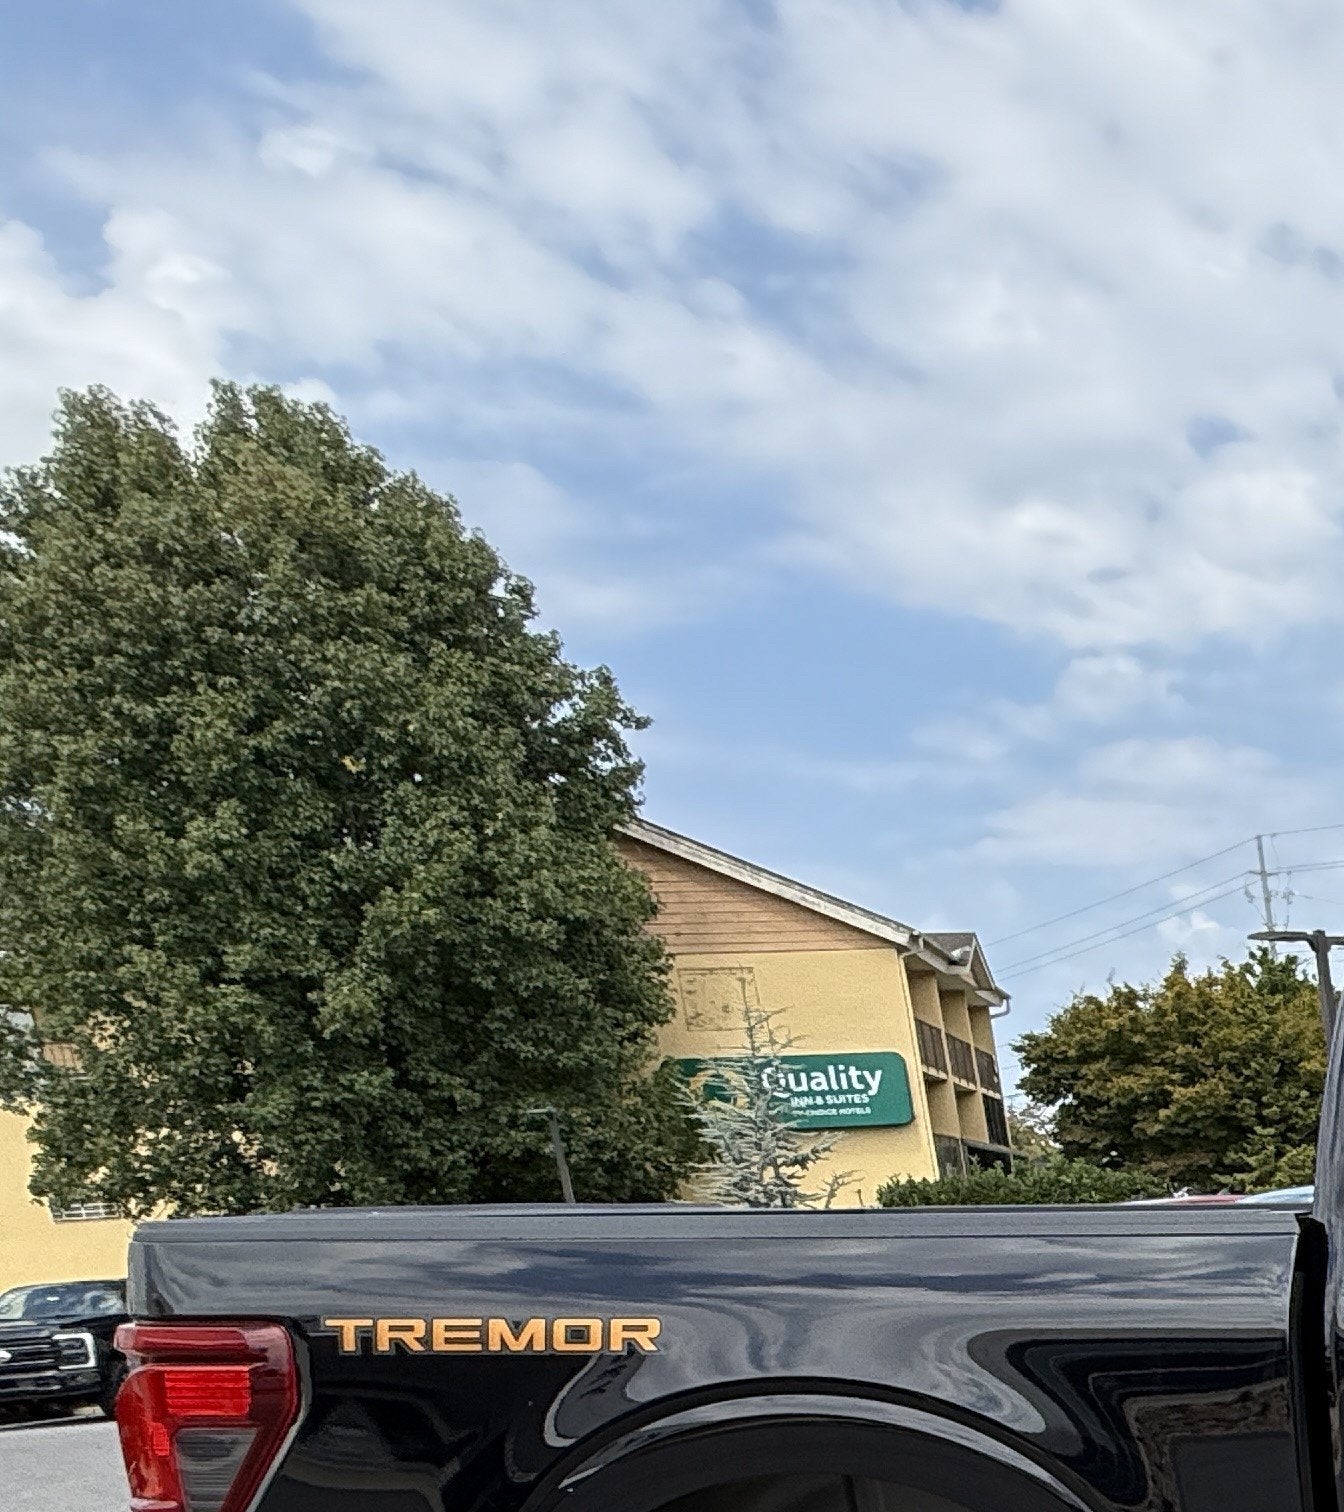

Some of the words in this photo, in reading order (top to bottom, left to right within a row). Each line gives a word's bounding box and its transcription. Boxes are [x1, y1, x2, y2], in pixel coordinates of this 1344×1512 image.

[761, 1064, 883, 1098] Quality
[825, 1093, 870, 1104] SUITES
[324, 1318, 662, 1352] TREMOR
